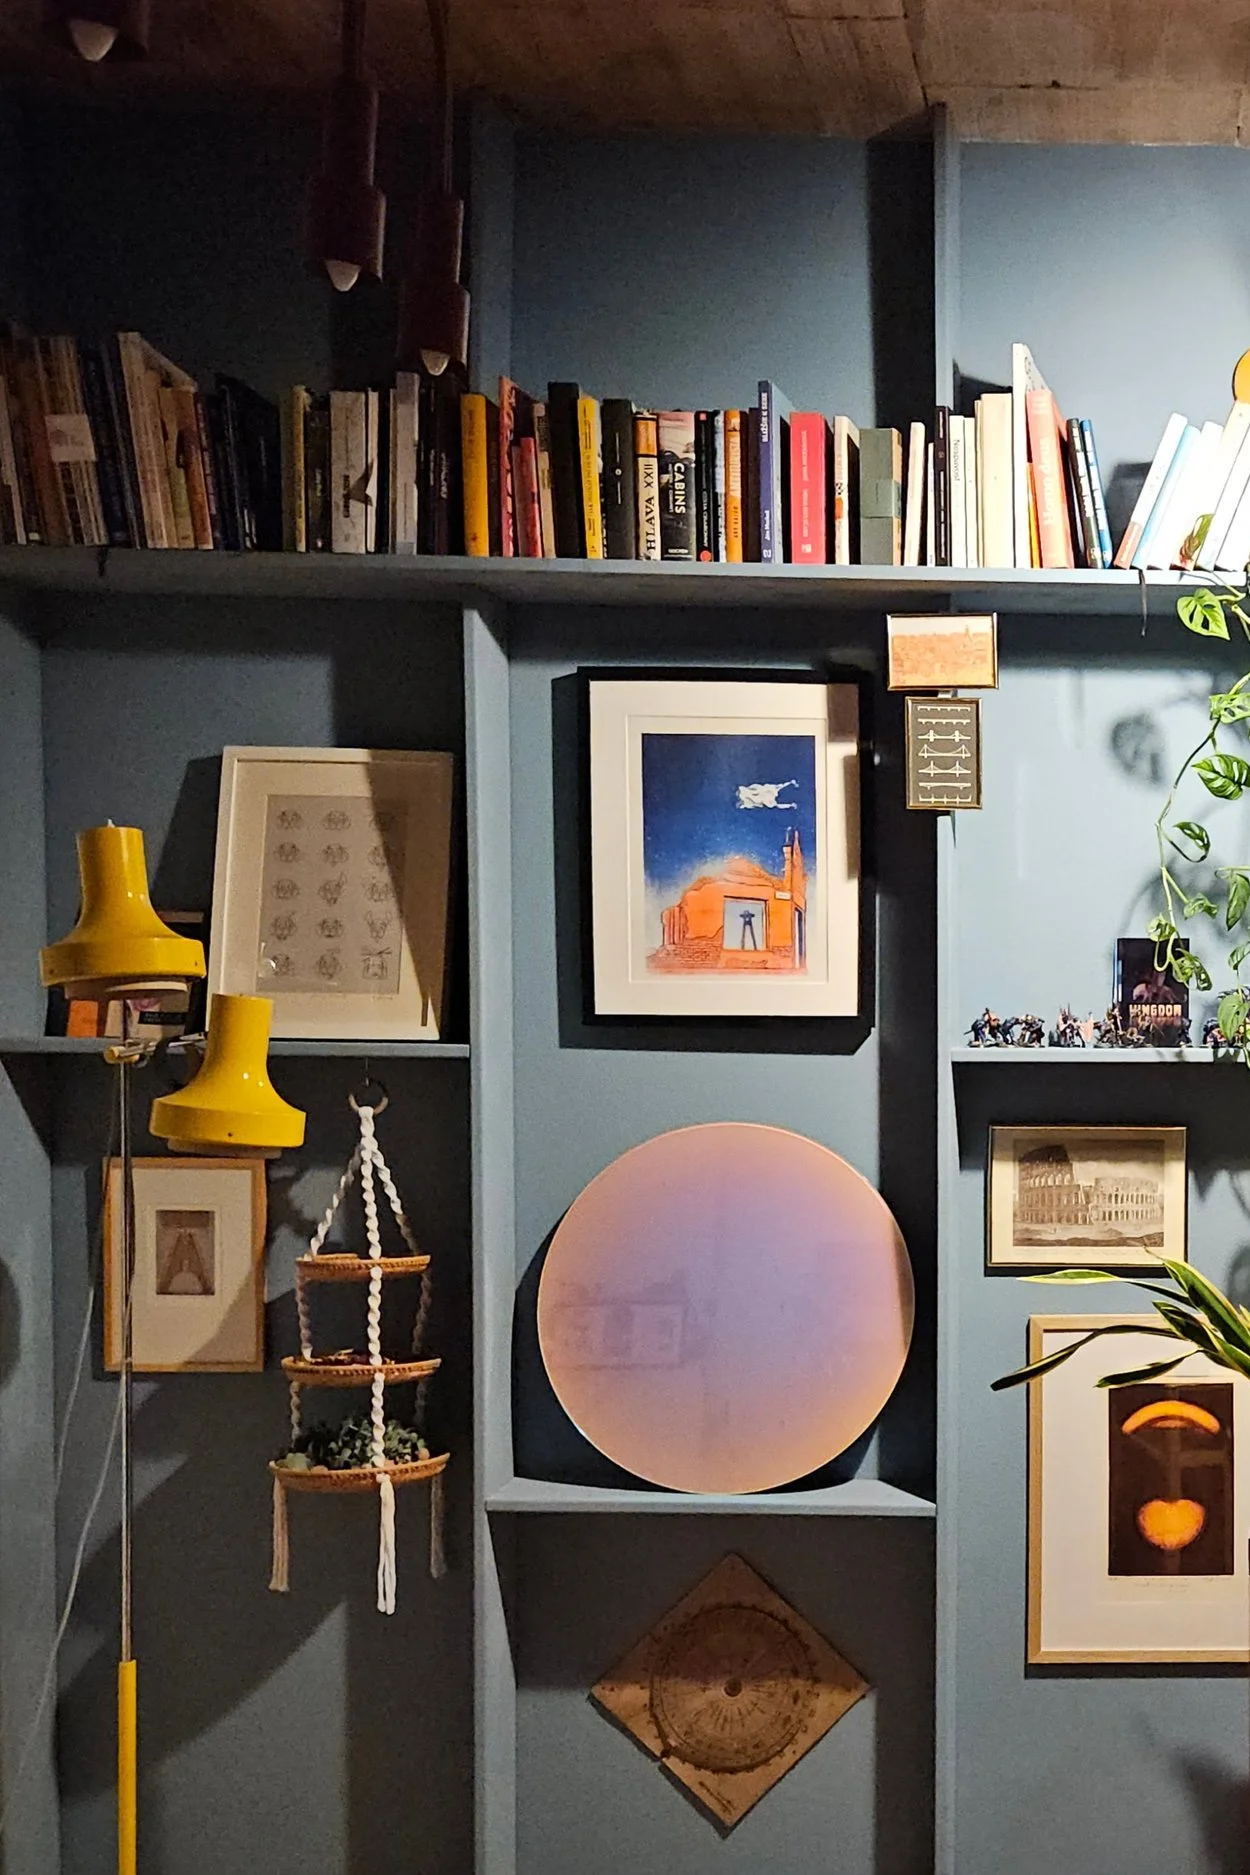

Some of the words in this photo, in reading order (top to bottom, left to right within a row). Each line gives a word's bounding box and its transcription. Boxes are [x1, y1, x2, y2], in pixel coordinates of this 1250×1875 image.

[644, 462, 654, 490] XXII
[674, 462, 686, 514] CABINS
[645, 494, 656, 552] HLAVA
